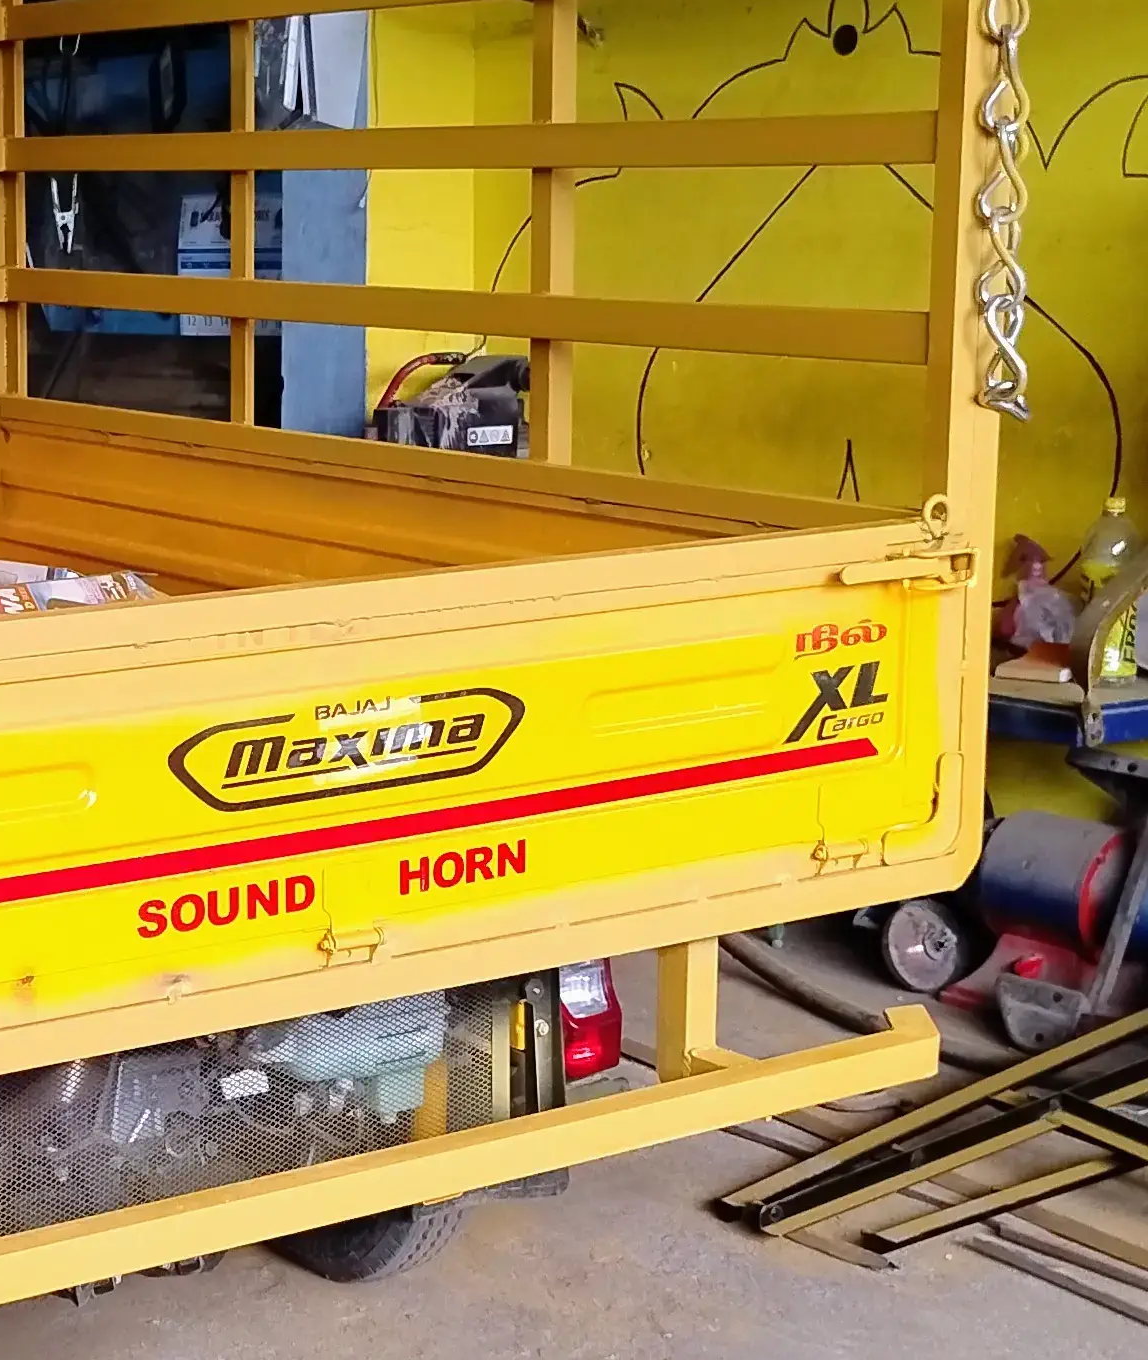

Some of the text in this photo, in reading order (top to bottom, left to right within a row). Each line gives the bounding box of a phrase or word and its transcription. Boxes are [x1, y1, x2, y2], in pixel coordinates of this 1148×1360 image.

[794, 618, 888, 661] நில்
[315, 696, 391, 721] BAJAJ
[782, 661, 889, 745] XL
[137, 839, 527, 939] SOUND HORN
